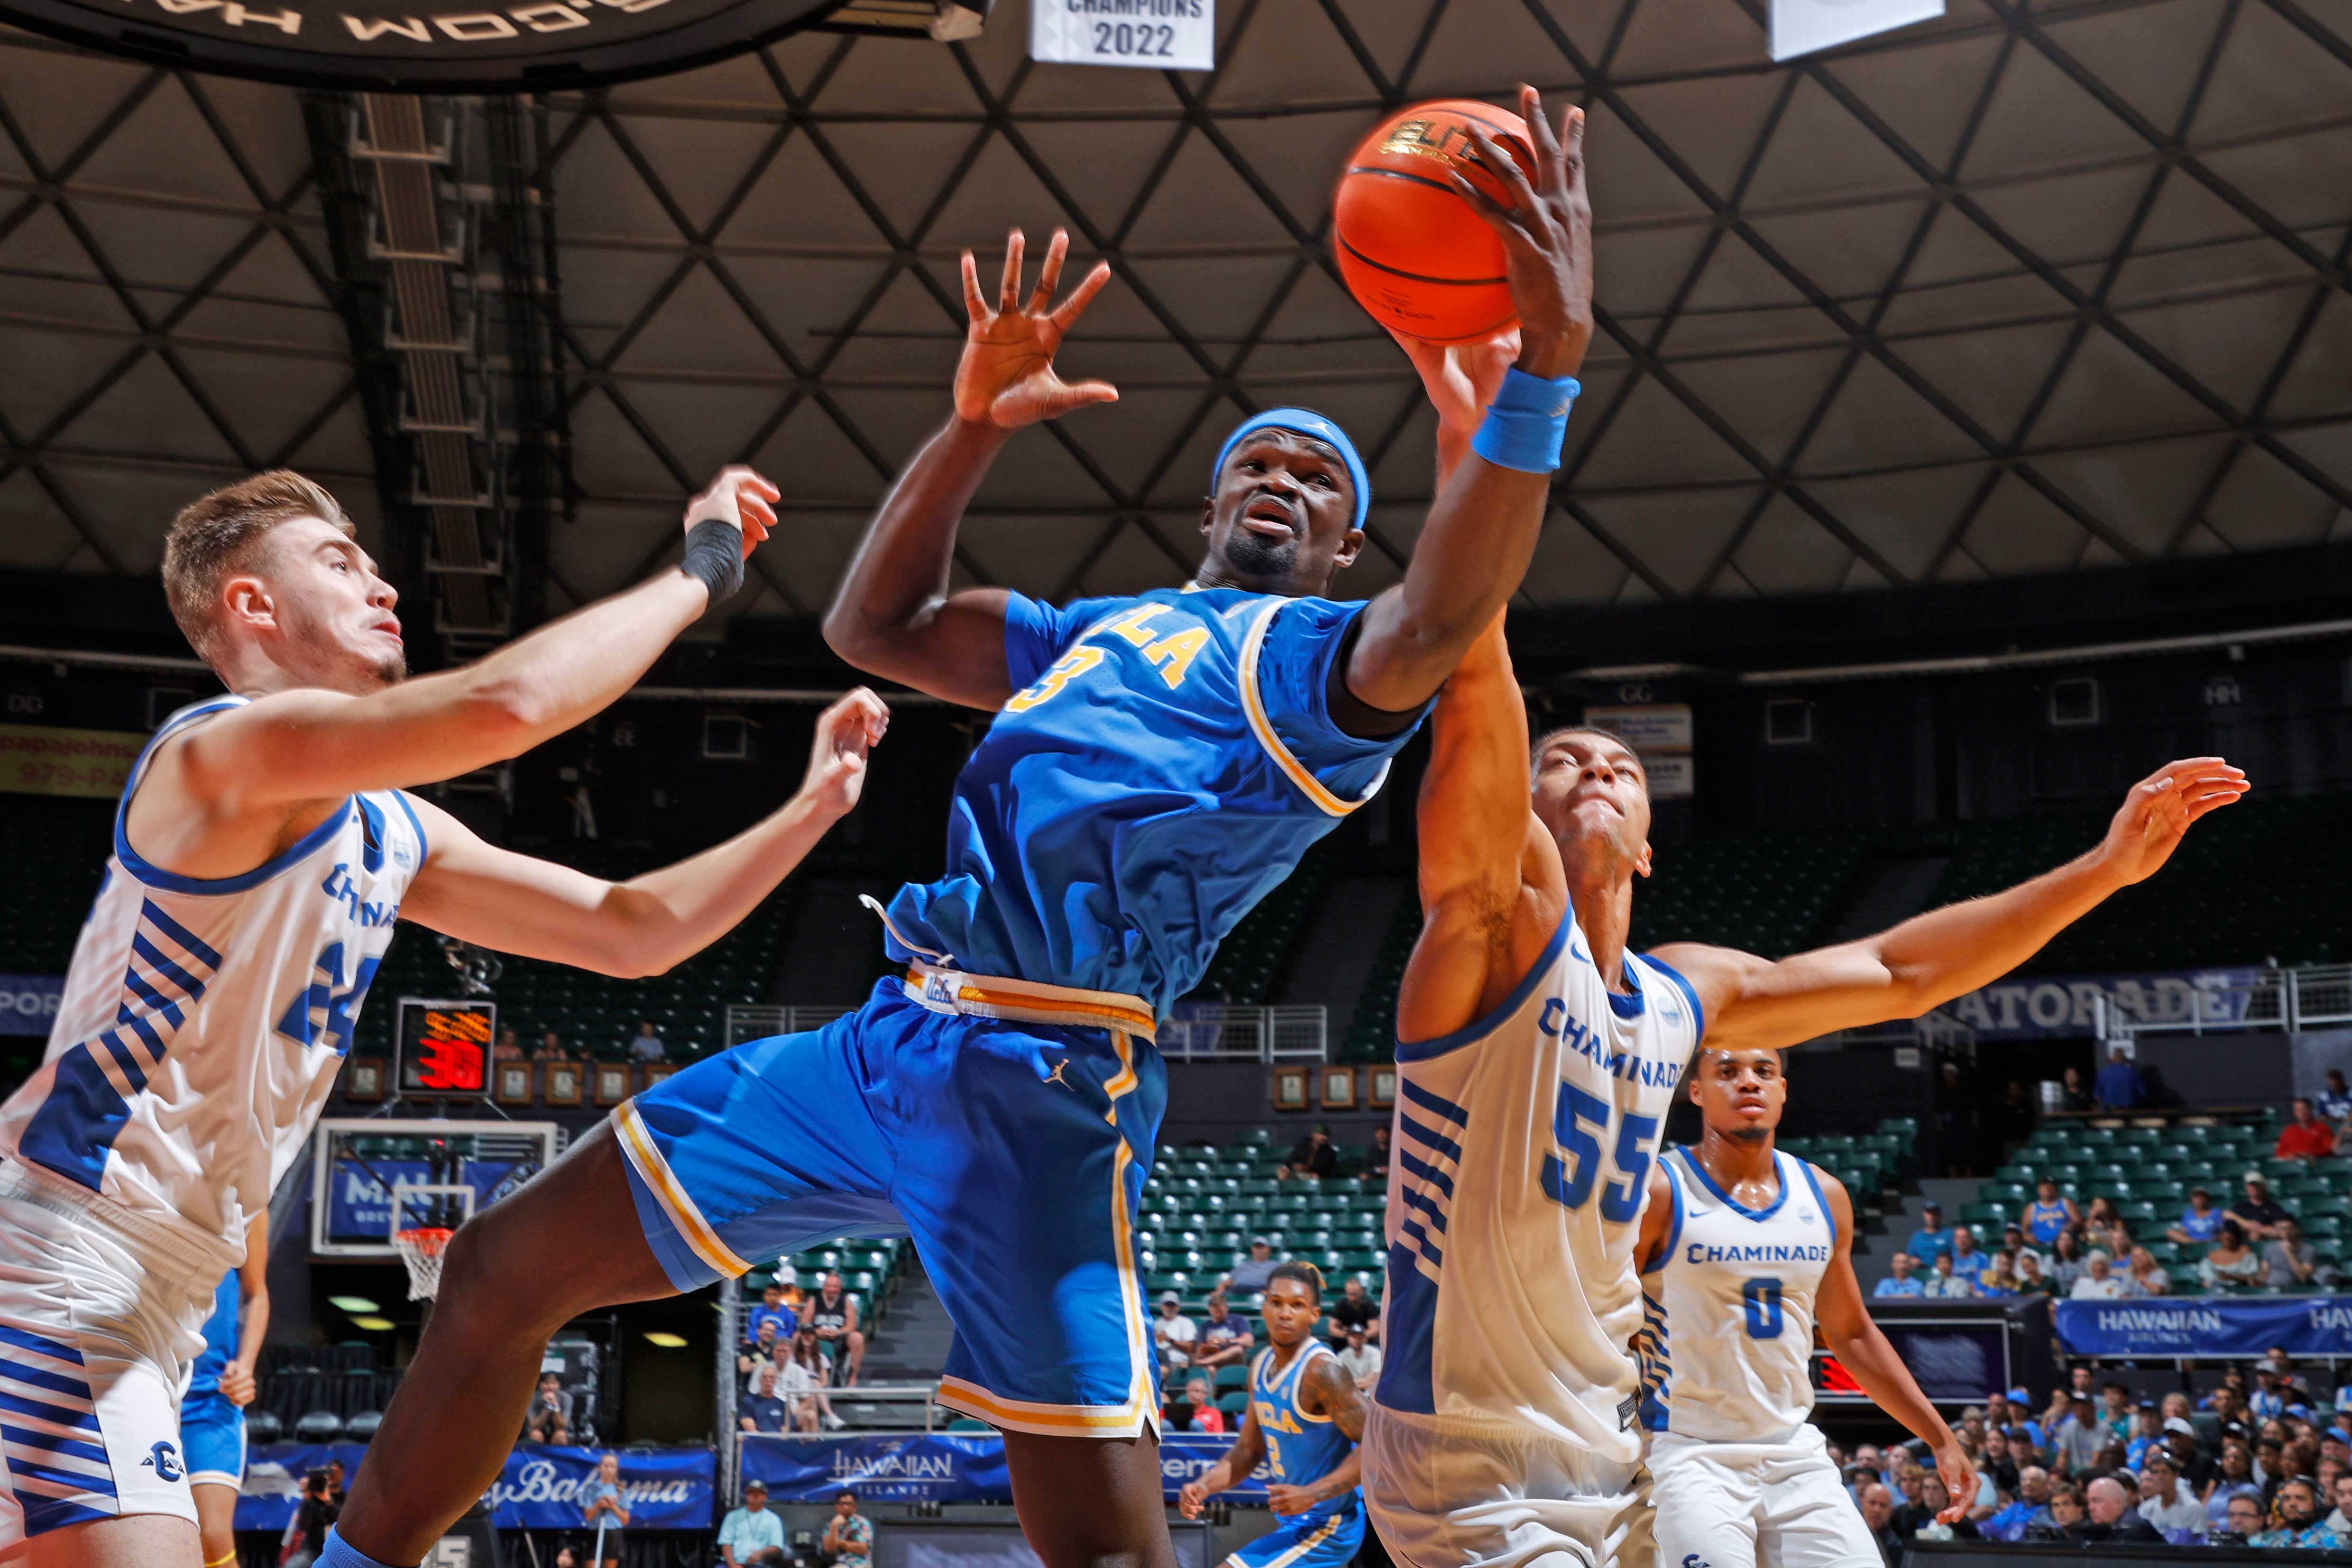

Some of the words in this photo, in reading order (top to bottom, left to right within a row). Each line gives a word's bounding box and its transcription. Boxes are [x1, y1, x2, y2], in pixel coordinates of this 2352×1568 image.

[1093, 22, 1175, 57] 2022
[1619, 683, 1653, 702] GG
[1947, 975, 2231, 1028] ATORADE
[1538, 998, 1682, 1089] CHAMINAD
[1538, 1078, 1659, 1226] 55
[1687, 1243, 1828, 1265] CHAMINADE
[1743, 1277, 1784, 1340] 0
[2098, 1309, 2222, 1331] HAWAIIAN
[833, 1449, 953, 1483] HAWAIIAN
[857, 1485, 929, 1495] ISLANDS
